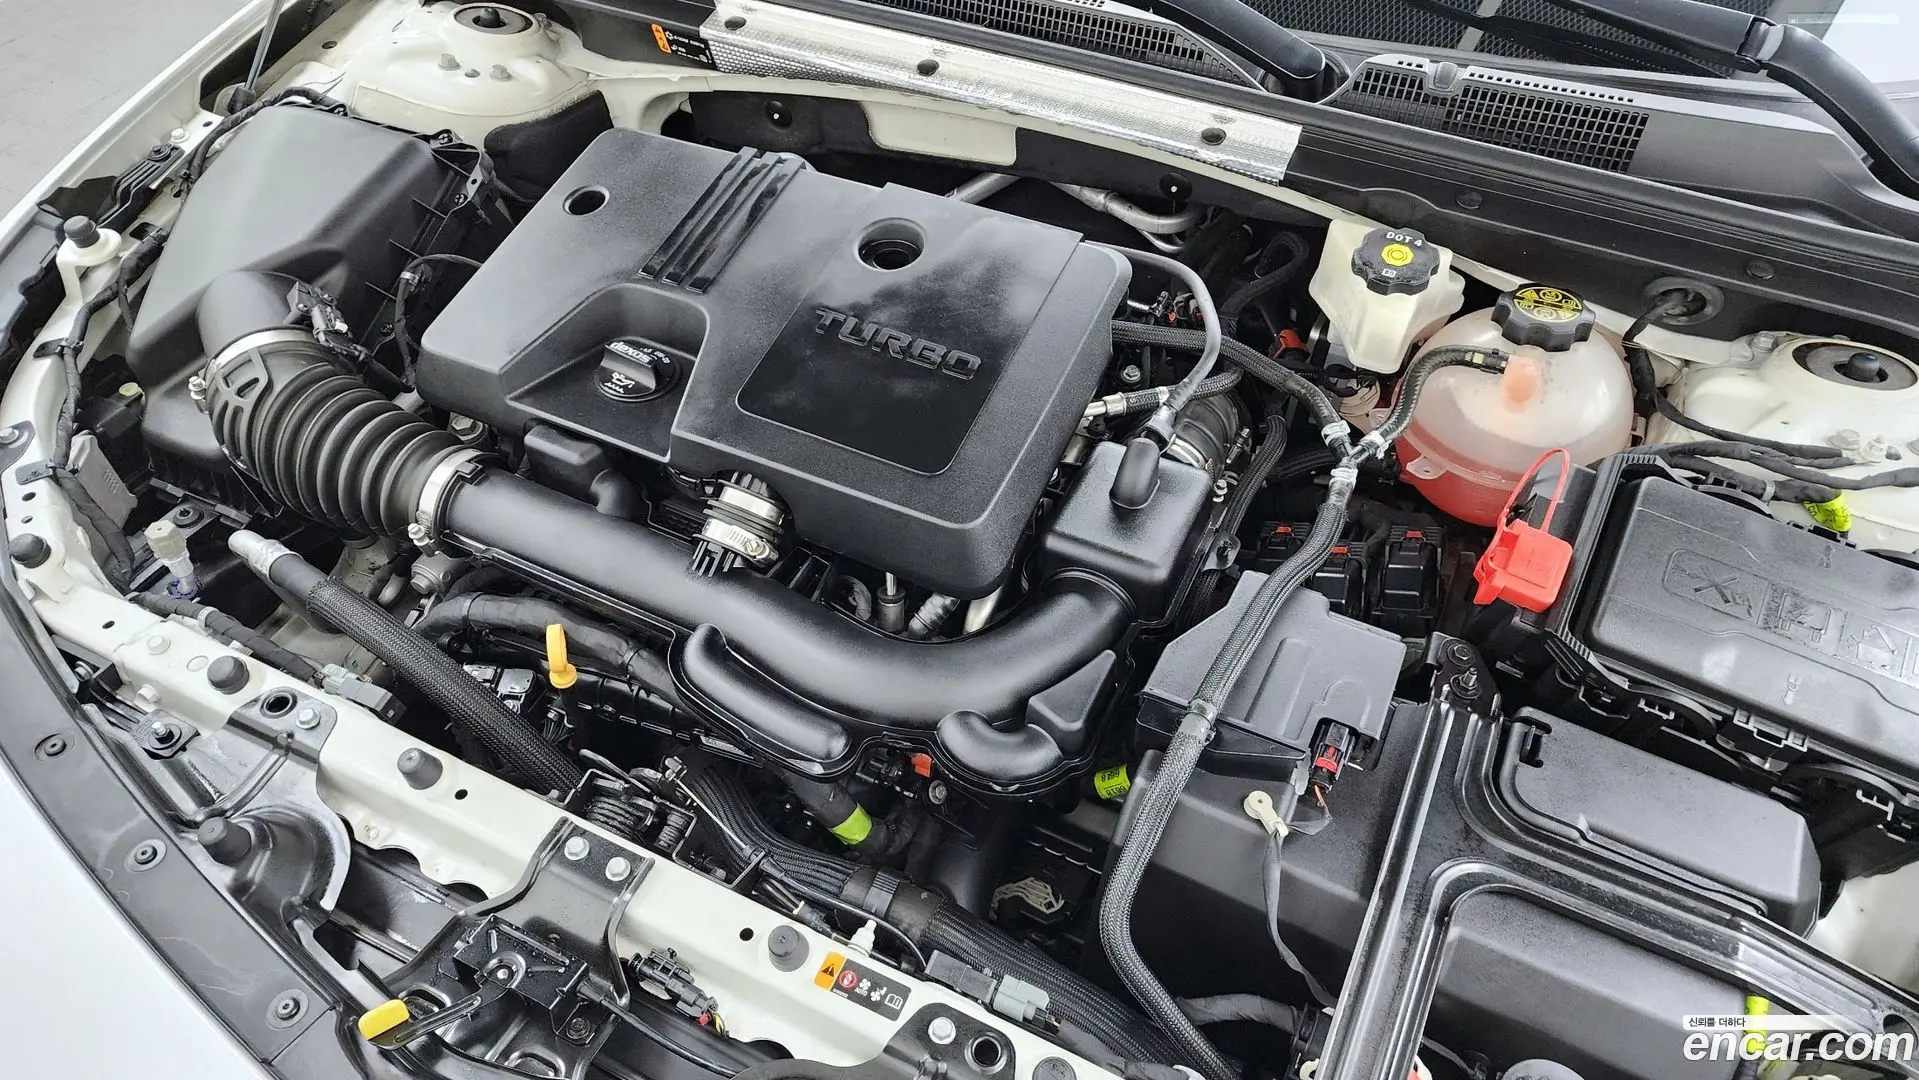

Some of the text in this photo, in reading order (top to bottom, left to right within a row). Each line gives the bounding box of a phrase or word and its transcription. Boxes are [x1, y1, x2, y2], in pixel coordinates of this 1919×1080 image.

[1386, 231, 1423, 247] DOT 4
[609, 341, 653, 363] dexos
[816, 306, 982, 381] TURBO
